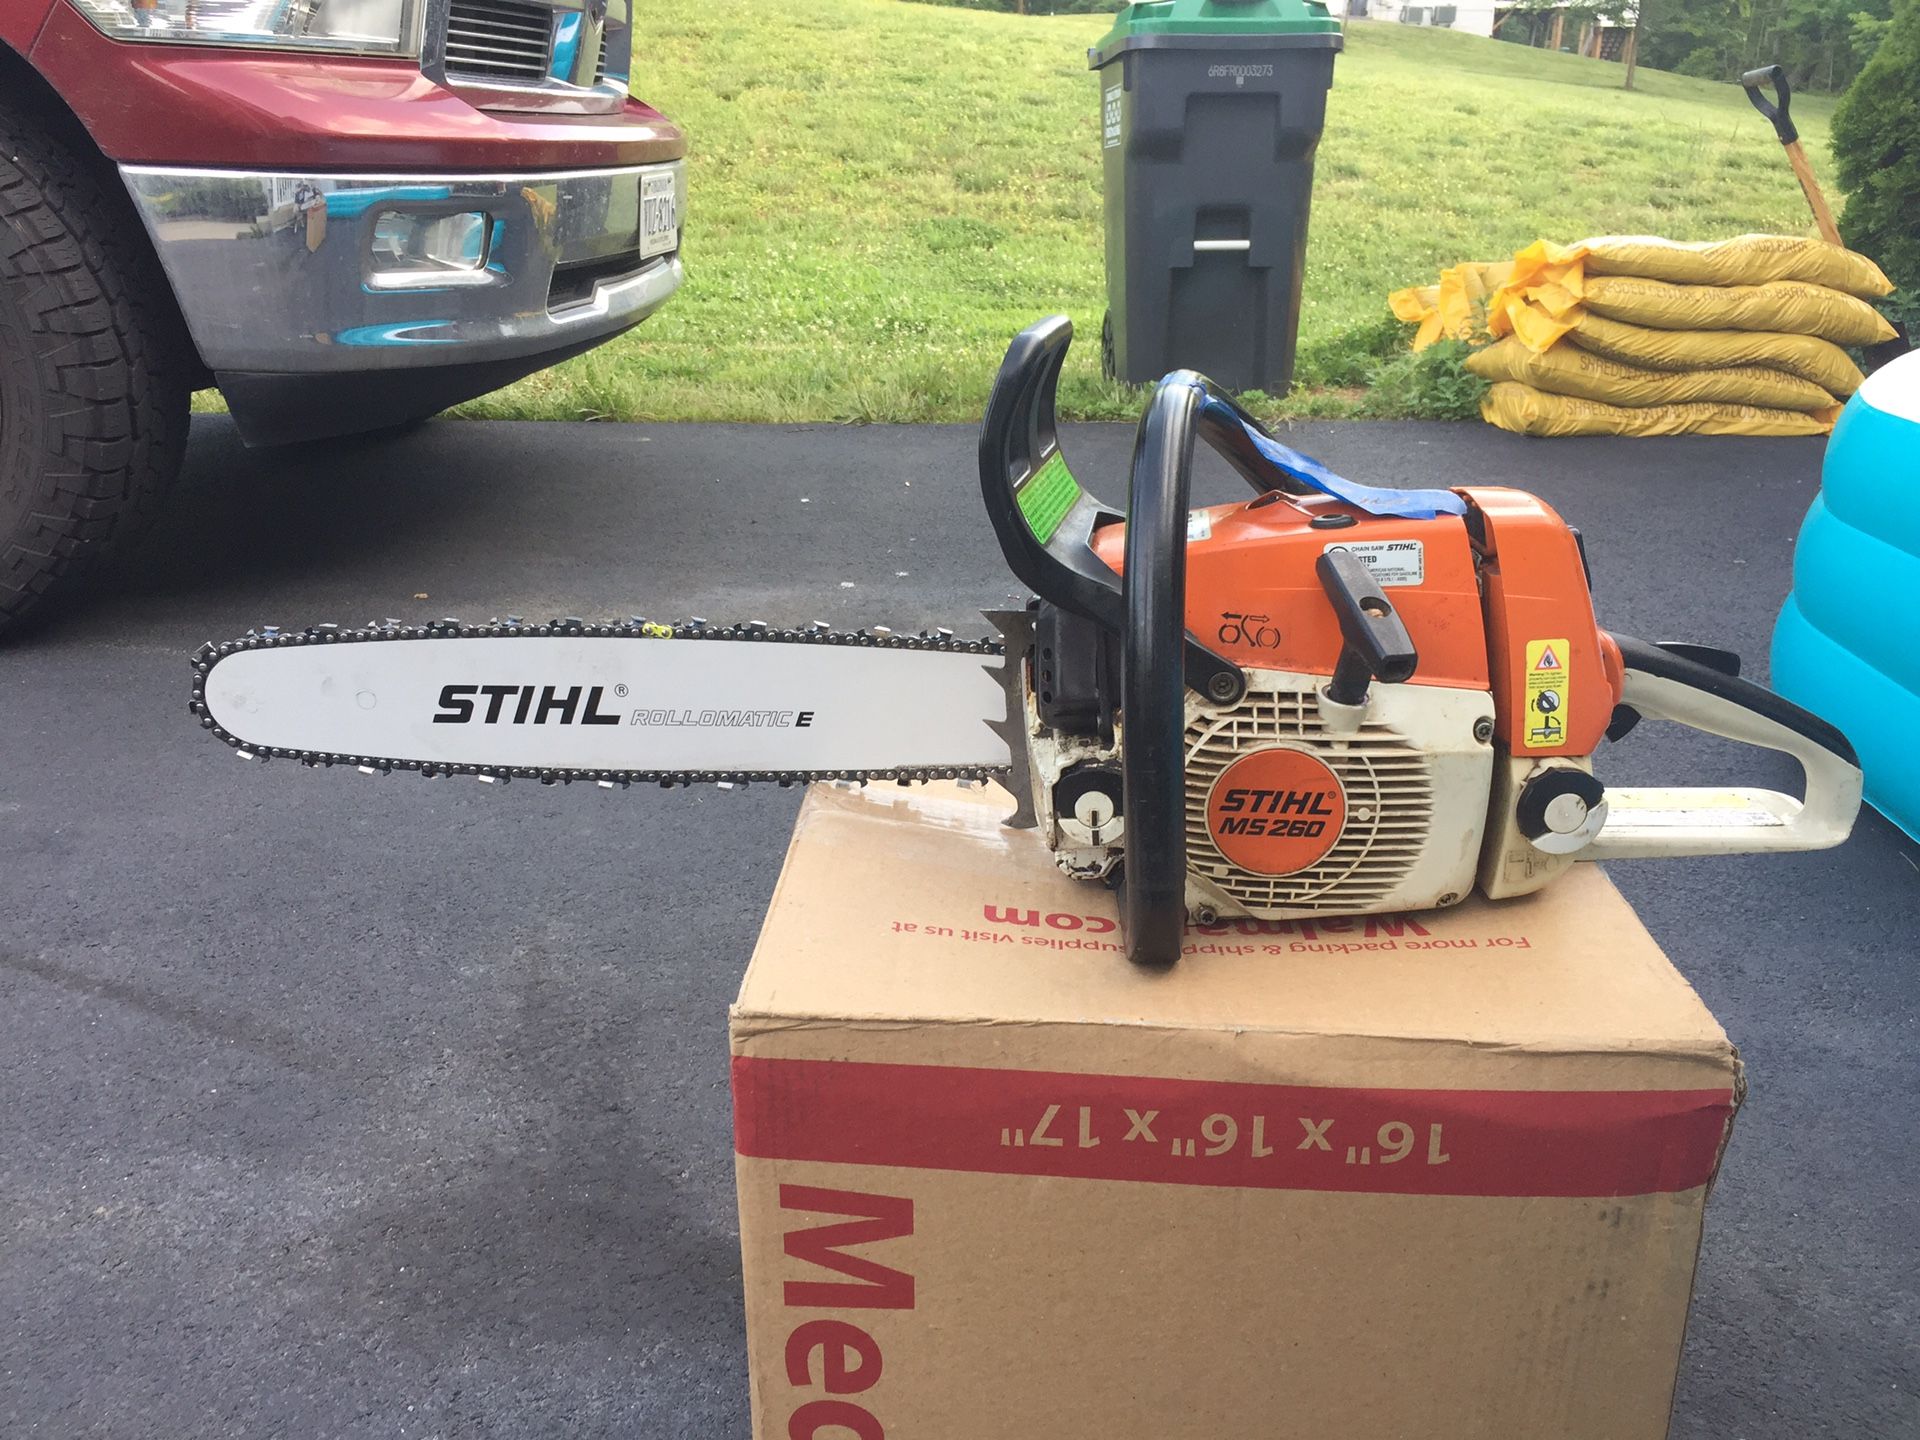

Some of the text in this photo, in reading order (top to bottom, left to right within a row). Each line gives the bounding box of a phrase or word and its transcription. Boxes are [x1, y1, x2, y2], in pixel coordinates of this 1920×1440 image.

[1358, 555, 1377, 563] STED
[1387, 543, 1416, 551] STIHL
[432, 684, 815, 728] STIHL ROLLOMATIC E
[1219, 789, 1333, 815] STIHL
[1218, 817, 1326, 838] MS 260
[891, 920, 1532, 956] For more packing & shipp supplies visit us at
[1000, 1104, 1100, 1148] 17"
[1170, 1113, 1273, 1158] 16"
[1345, 1121, 1450, 1165] 16"
